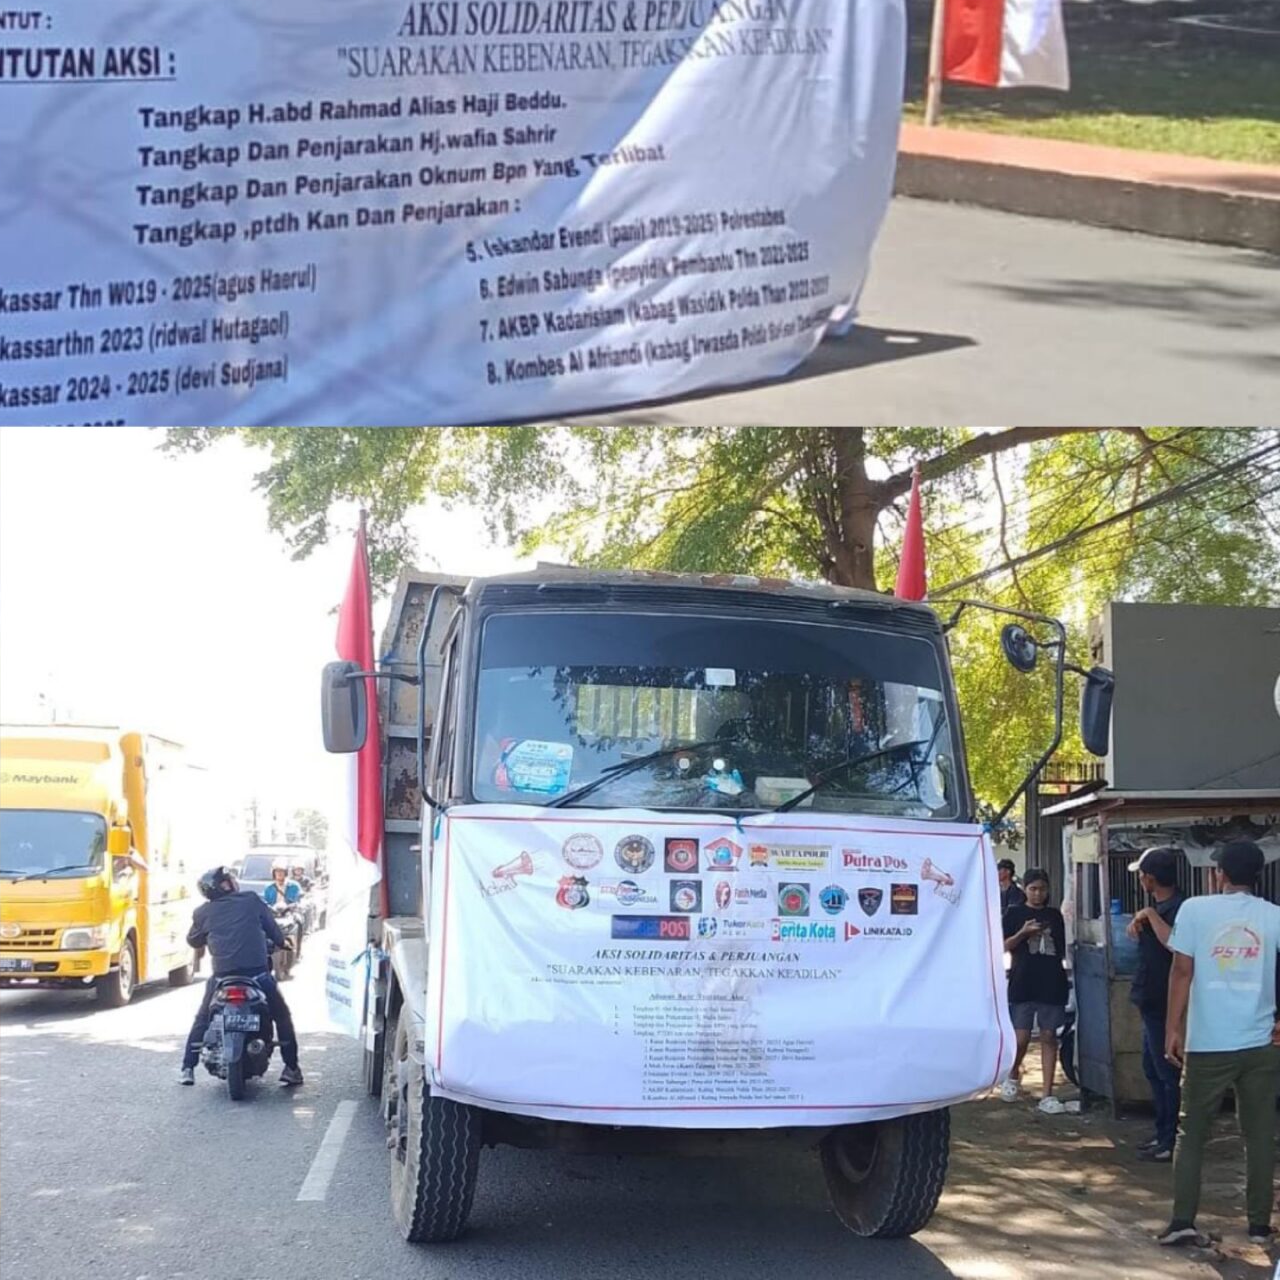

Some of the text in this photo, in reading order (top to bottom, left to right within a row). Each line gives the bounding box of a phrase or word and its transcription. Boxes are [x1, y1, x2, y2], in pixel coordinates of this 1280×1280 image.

[397, 1, 459, 36] AKSI
[464, 0, 618, 36] SOLIDARITAS
[622, 0, 638, 32] &
[103, 47, 160, 76] AKSI
[337, 43, 476, 78] "SUARAKAN
[138, 90, 567, 132] Tangkap H.abd Rahmad Alias Haji Beddu.
[137, 124, 558, 170] Tangkap Dan Penjarakan Hj.wafia Sahrir
[136, 144, 666, 209] Tangkap Dan Penjarakan Oknum Bpn Yang Terlibat
[133, 219, 236, 247] Tangkap
[243, 214, 299, 240] ,ptdh
[307, 211, 348, 230] Kan
[356, 207, 395, 227] Dan
[402, 197, 509, 224] Penjarakan
[466, 242, 484, 262] 5.
[68, 284, 102, 308] Thn
[109, 279, 157, 306] W019
[260, 263, 316, 291] Haerul)
[498, 272, 539, 298] Edwin
[543, 267, 604, 293] Sabunga
[100, 326, 144, 354] 2023
[480, 320, 494, 342] 7.
[498, 314, 540, 340] AKBP
[67, 375, 111, 403] 2024
[128, 370, 169, 396] 2025
[175, 365, 216, 395] (devi
[487, 362, 502, 384] 8.
[505, 354, 565, 382] Kombes
[843, 853, 908, 869] Putra Pos
[809, 923, 836, 938] Kota
[592, 949, 800, 962] AKSI SOLIDARITAS & PERJUANGAN
